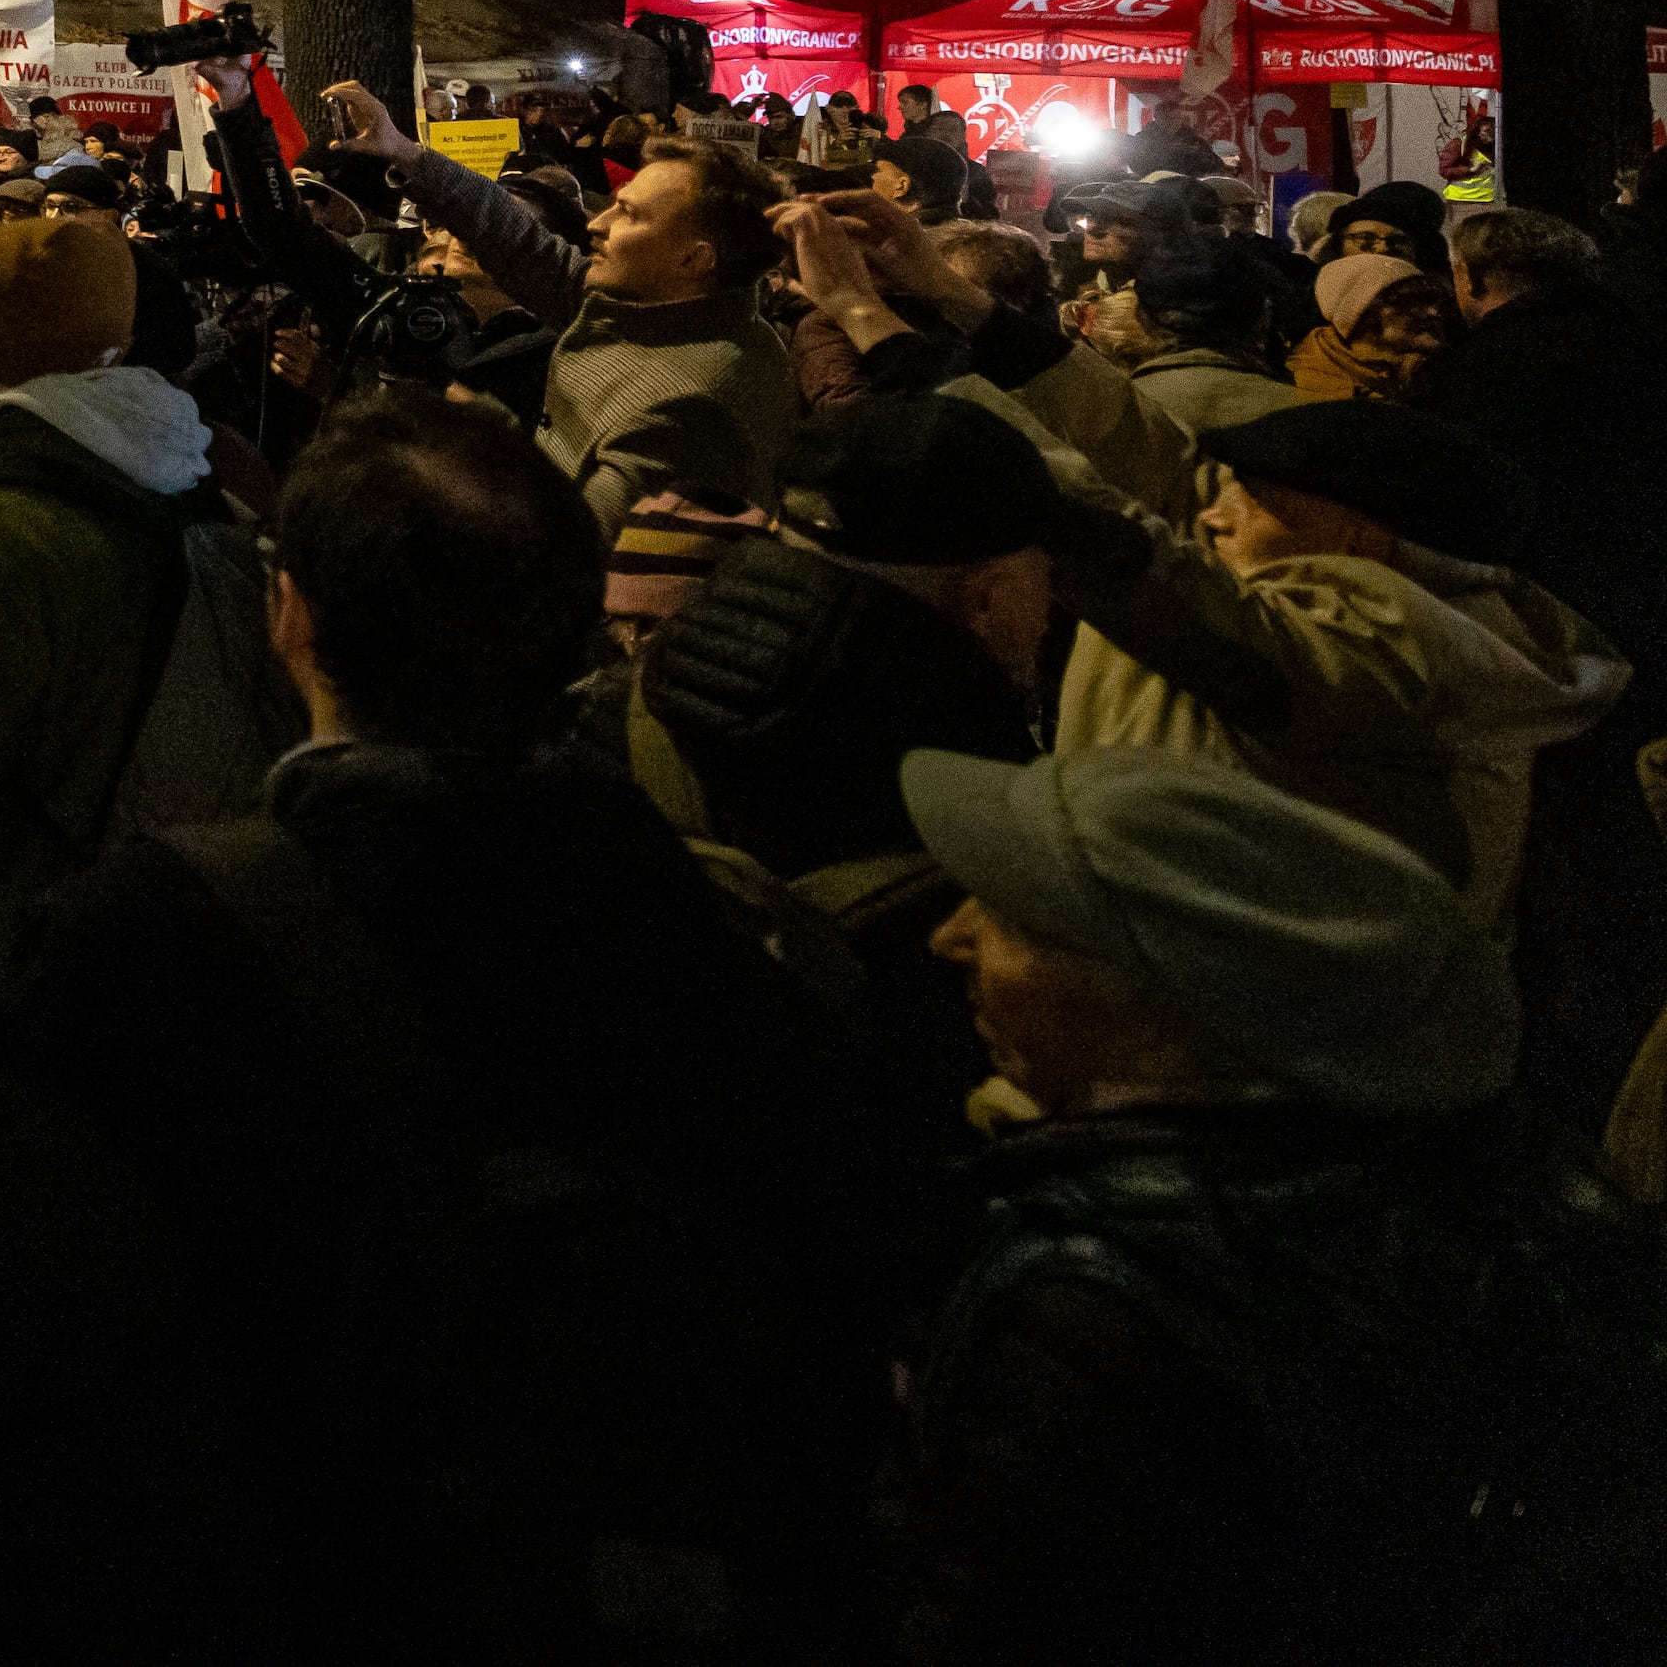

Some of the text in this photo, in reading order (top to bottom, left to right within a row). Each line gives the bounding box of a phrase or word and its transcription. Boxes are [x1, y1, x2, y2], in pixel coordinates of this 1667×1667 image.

[938, 41, 1190, 66] RUCHOBRONYGRANI
[1300, 48, 1497, 73] RUCHOBRONYGRANIC.PL
[94, 61, 128, 74] KLUB
[54, 75, 166, 94] GAZETY POLSKIEJ
[67, 99, 151, 114] KATOWICE II
